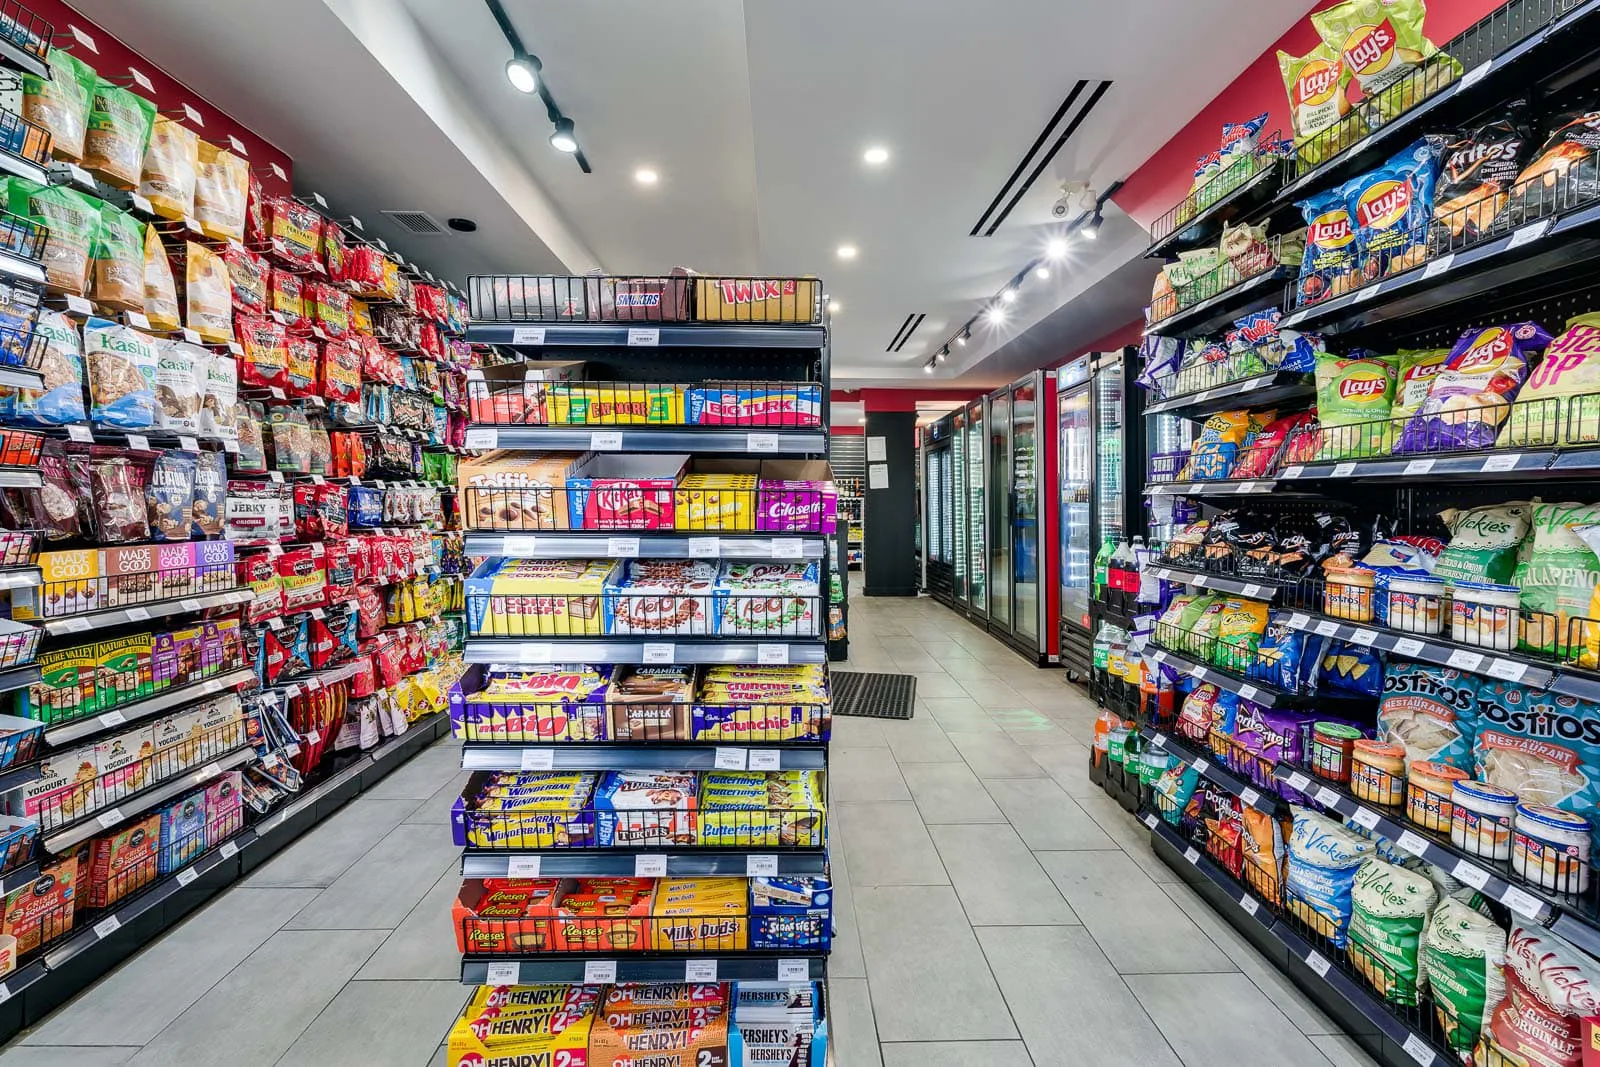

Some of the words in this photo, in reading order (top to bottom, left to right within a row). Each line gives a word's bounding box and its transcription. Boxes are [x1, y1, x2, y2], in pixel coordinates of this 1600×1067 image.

[1344, 29, 1392, 72] Lay's
[1300, 63, 1339, 101] Lay's
[1362, 186, 1407, 223] Lay's
[715, 279, 780, 304] TWIX
[99, 333, 152, 358] Kashi
[1459, 334, 1508, 368] Lay's
[158, 358, 194, 372] Kashi
[1344, 378, 1386, 396] Lay's
[709, 401, 740, 416] BIG
[743, 400, 792, 414] TURK
[469, 472, 553, 497] Toffifee
[231, 503, 266, 513] JERKY
[770, 502, 826, 517] Glosette
[119, 548, 151, 562] MADE
[161, 546, 189, 558] MADE
[203, 543, 229, 554] MADE
[51, 552, 89, 566] MADE
[161, 556, 189, 567] GOOD
[204, 552, 229, 563] GOOD
[51, 565, 90, 578] GOOD
[119, 560, 151, 572] GOOD
[634, 597, 675, 616] Aero
[743, 597, 782, 617] Aero
[100, 639, 127, 654] NATURE
[127, 633, 151, 647] VALLEY
[66, 646, 94, 660] VALLEY
[637, 667, 682, 675] CARAMILK
[528, 674, 581, 689] Big
[626, 707, 671, 718] CARAMLK
[1385, 698, 1451, 717] RESTAURANT
[506, 715, 568, 737] Big
[721, 716, 789, 733] crunchie
[1488, 733, 1573, 763] RESTAURANT
[104, 755, 134, 770] YOGOURT
[27, 778, 68, 797] YOGOURT
[508, 784, 571, 797] WUNDERBAR
[485, 825, 546, 842] WUNDERBAR
[702, 823, 776, 837] Butterfinger
[26, 889, 60, 911] CRISPY
[488, 891, 528, 902] Reese's
[25, 897, 59, 917] SQUARES
[479, 905, 521, 916] Reese's
[469, 929, 505, 941] Reese's
[561, 924, 604, 937] Reese's
[661, 926, 695, 941] Milk
[698, 920, 739, 938] Duds
[487, 991, 510, 1007] OH
[511, 988, 565, 1004] HENRY!
[570, 987, 582, 1002] 2
[609, 989, 633, 1003] OH
[635, 985, 689, 1001] HENRY!
[692, 984, 704, 1000] 2
[740, 991, 789, 1001] HERSHEY'S
[492, 1013, 550, 1035] HENRY!
[552, 1011, 567, 1033] 2
[607, 1013, 632, 1028] OH
[1526, 1006, 1570, 1039] RECIPE
[628, 1030, 687, 1051] HENRY!
[698, 1050, 712, 1067] 2
[750, 1048, 792, 1061] HERSHEY'S
